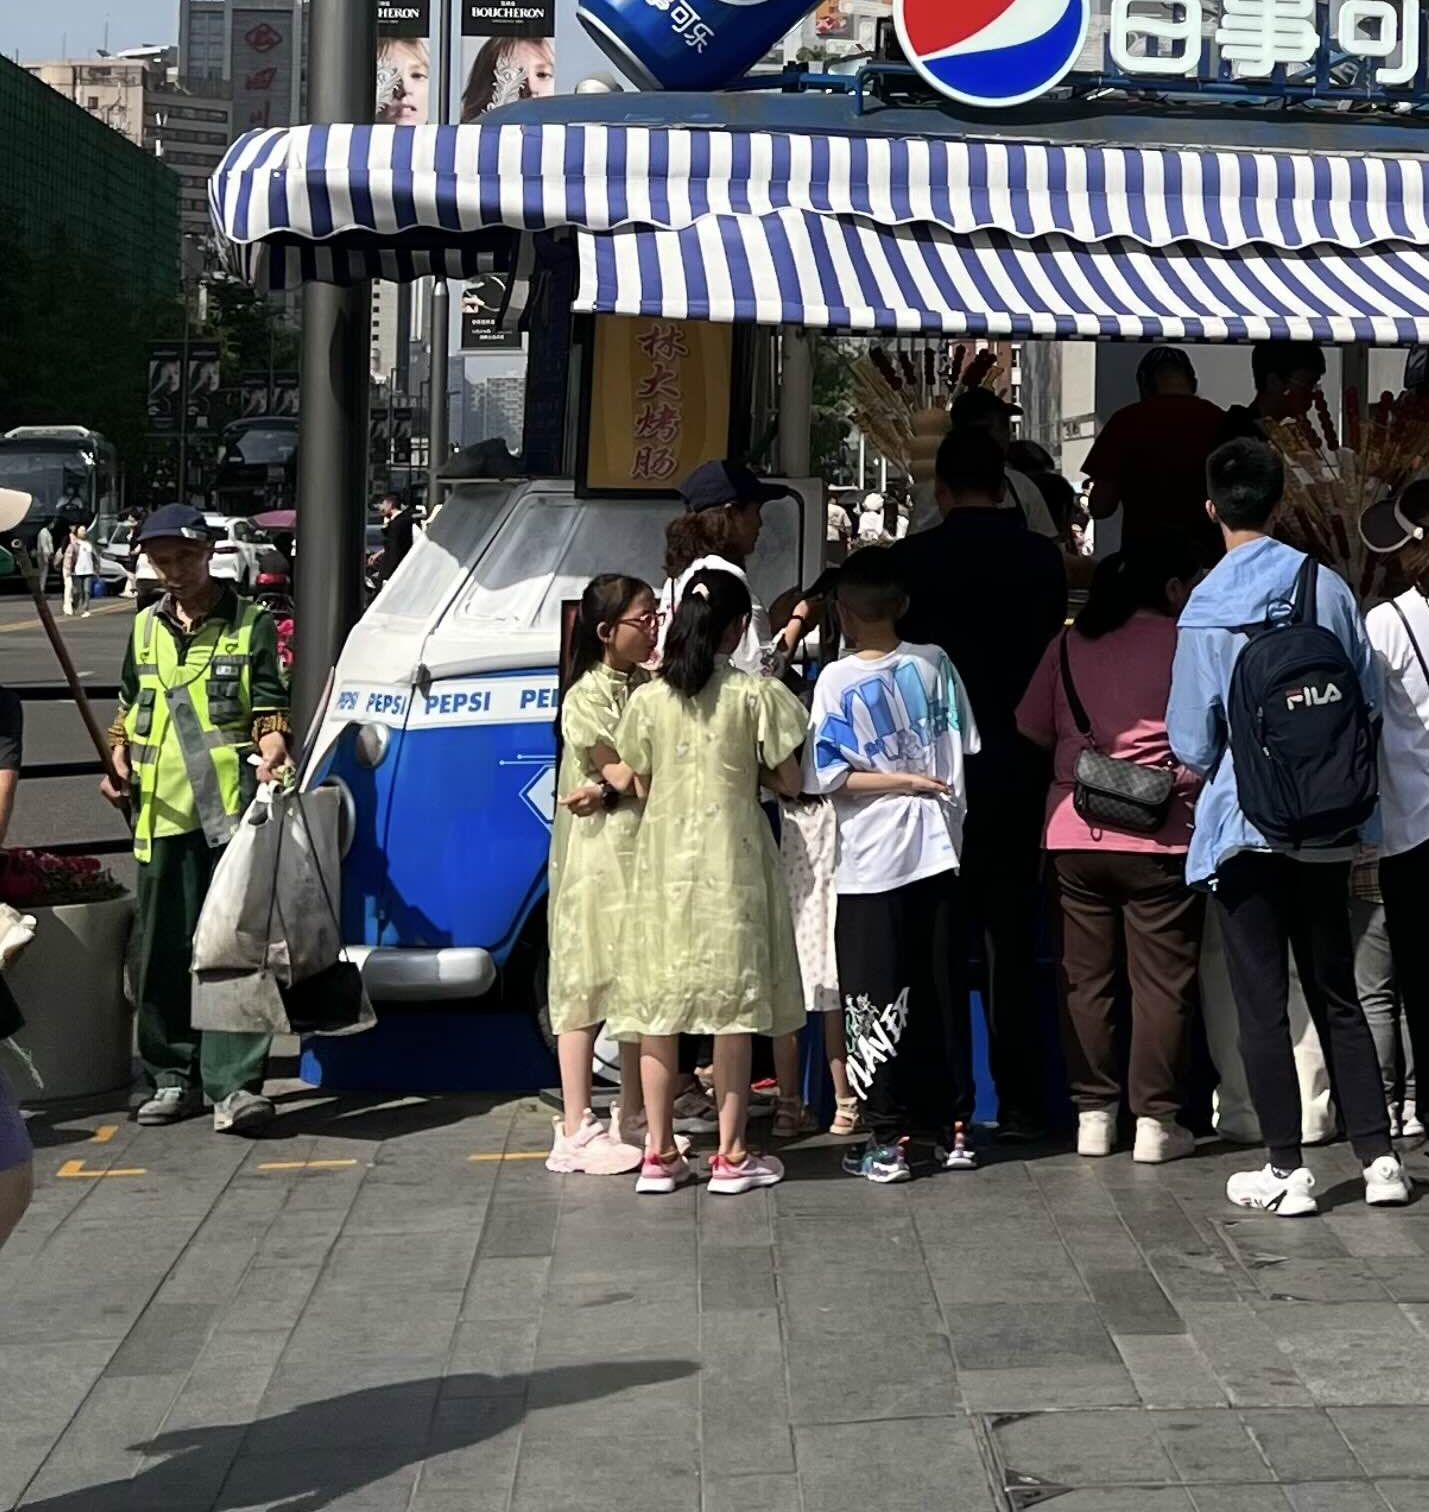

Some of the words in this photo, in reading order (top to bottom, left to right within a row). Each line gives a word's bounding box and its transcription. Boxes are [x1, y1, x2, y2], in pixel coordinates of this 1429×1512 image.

[471, 6, 545, 19] BOUCHERON
[366, 692, 407, 715] PEPSI
[425, 690, 491, 716] PEPSI
[1285, 682, 1343, 711] FILA
